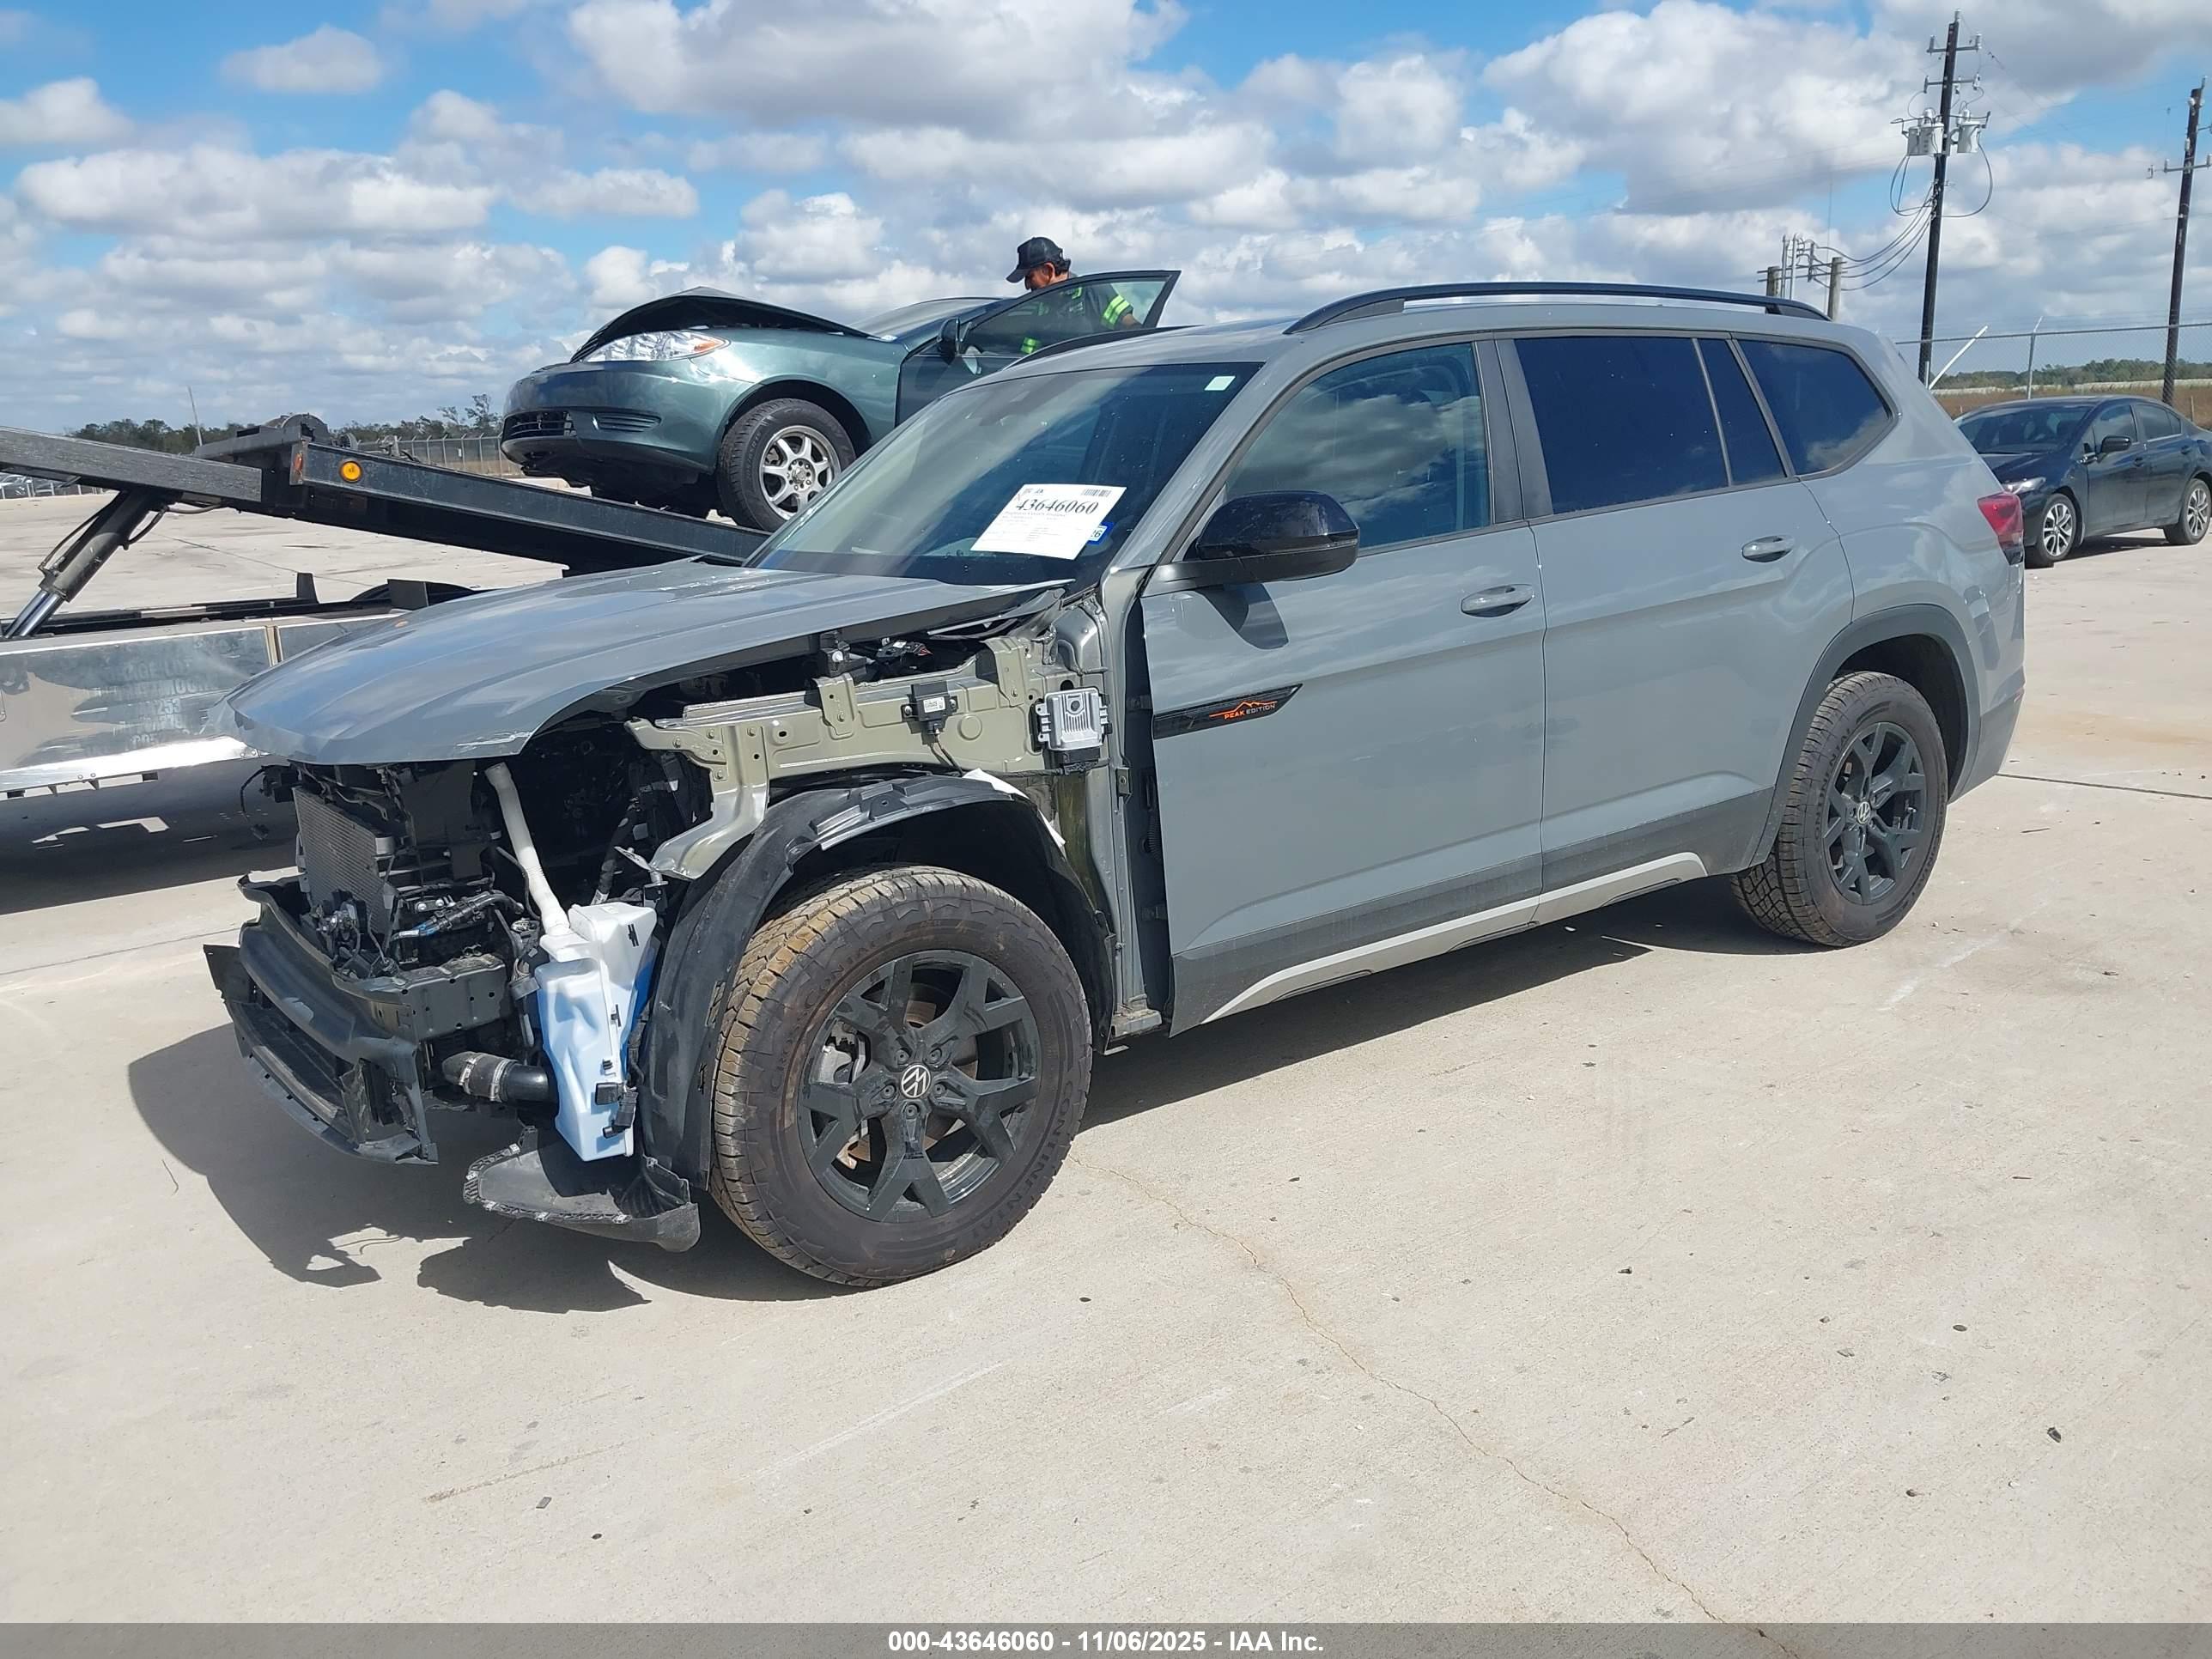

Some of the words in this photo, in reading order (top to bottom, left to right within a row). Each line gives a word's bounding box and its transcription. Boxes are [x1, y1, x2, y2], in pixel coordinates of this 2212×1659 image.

[1016, 499, 1099, 514] 43646060
[1224, 709, 1245, 720] PEAK
[1246, 703, 1275, 714] EDITION
